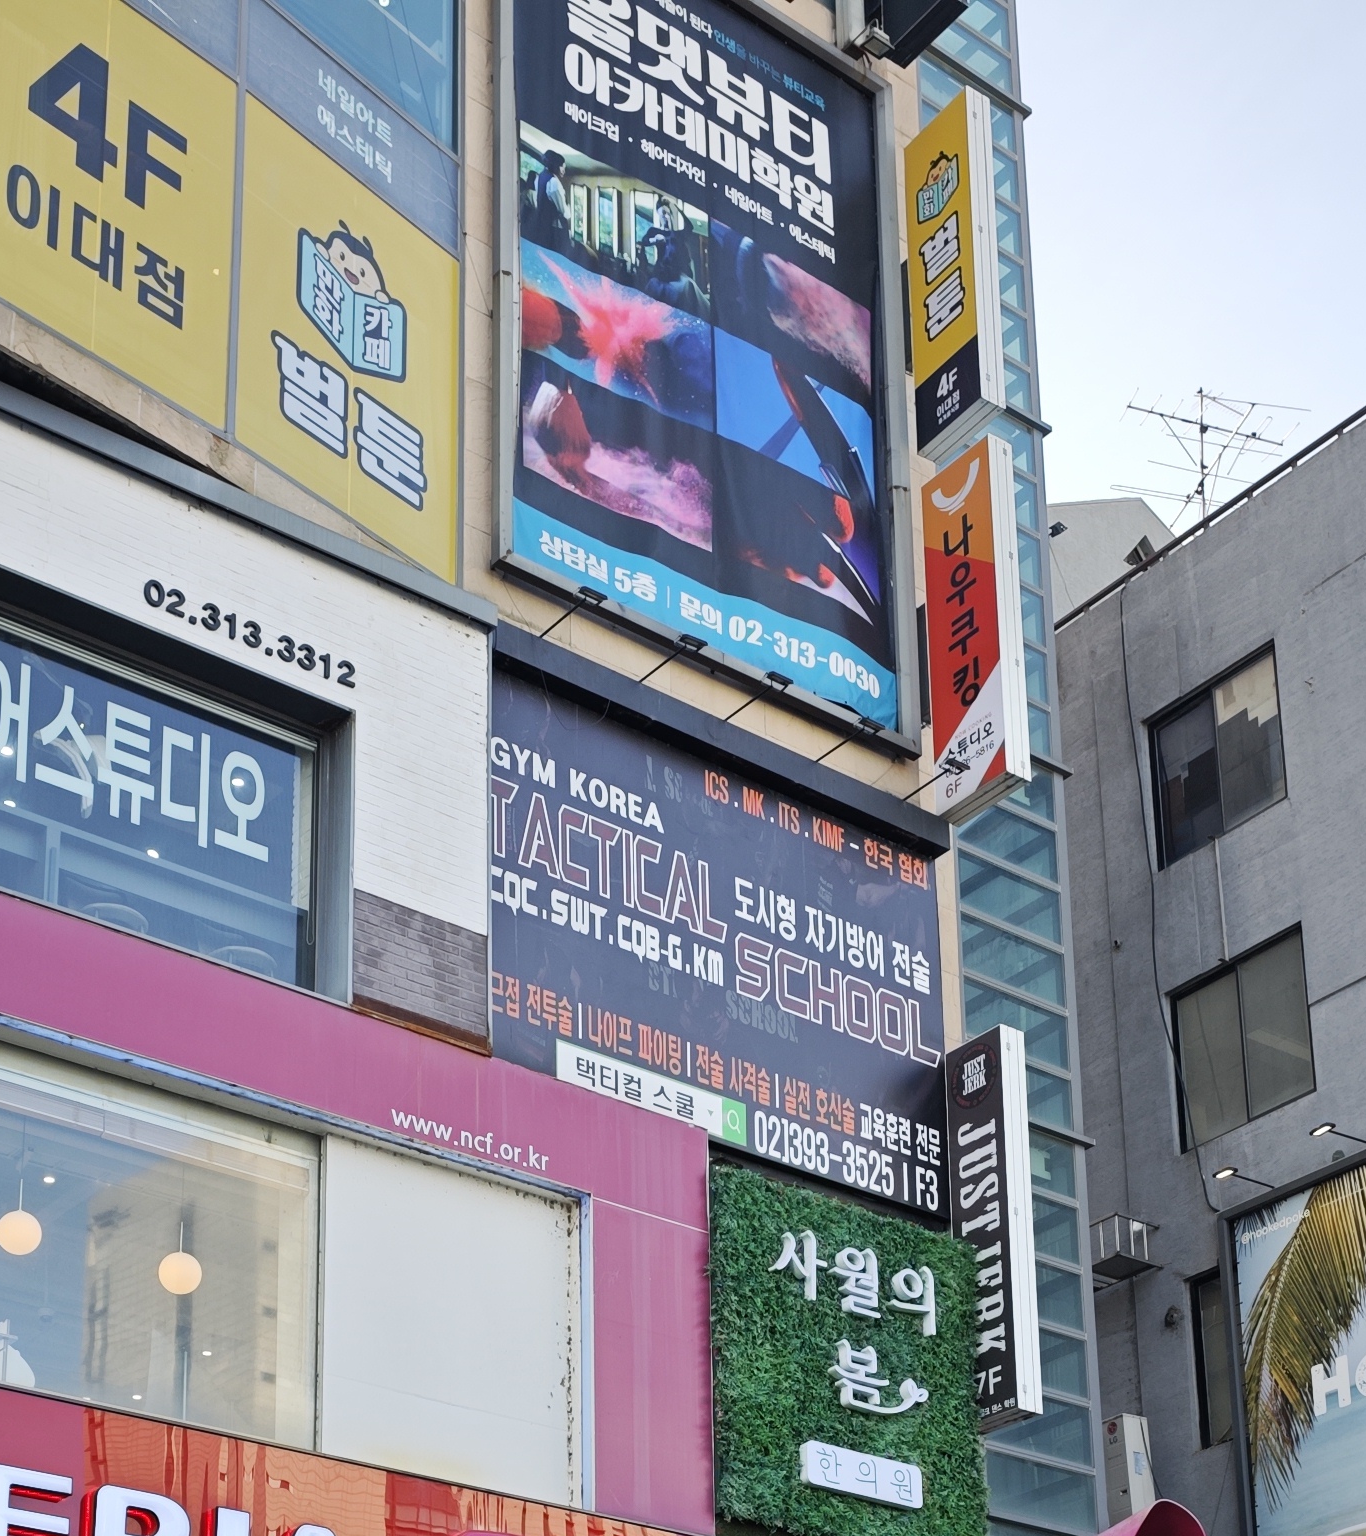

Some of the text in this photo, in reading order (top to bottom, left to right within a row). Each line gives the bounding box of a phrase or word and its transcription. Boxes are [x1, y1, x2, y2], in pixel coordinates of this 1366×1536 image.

[28, 42, 188, 209] 4F
[316, 68, 393, 148] 네일아트
[316, 104, 393, 185] 에스테틱
[564, 43, 836, 236] 아카데미학원
[564, 103, 836, 265] 메이크업 헤어디자인 네일아트 에스테틱
[6, 163, 185, 330] 이대점
[312, 256, 344, 345] 만화
[363, 306, 393, 371] 카페
[936, 389, 960, 417] 이대점
[937, 367, 958, 398] 4F
[143, 579, 357, 688] 02.313.3312
[538, 529, 881, 699] 상담실 5층 문의 02-313-0030
[943, 514, 981, 707] 나우쿠킹
[491, 736, 664, 834] GYM KOREA
[743, 783, 893, 876] MK ITS 한국
[946, 777, 962, 798] 6F
[735, 876, 931, 995] 도시형 자기방어 전술
[735, 933, 941, 1068] SCHOOL
[576, 1056, 695, 1121] 택티컬 스쿨
[587, 1005, 940, 1166] 나이프 전술 사격술 실전 교육훈련 전문
[391, 1108, 549, 1171] www.ncf.or.kr
[916, 1165, 937, 1211] F3
[957, 1118, 1002, 1237] JUST
[768, 1230, 936, 1337] 사월의
